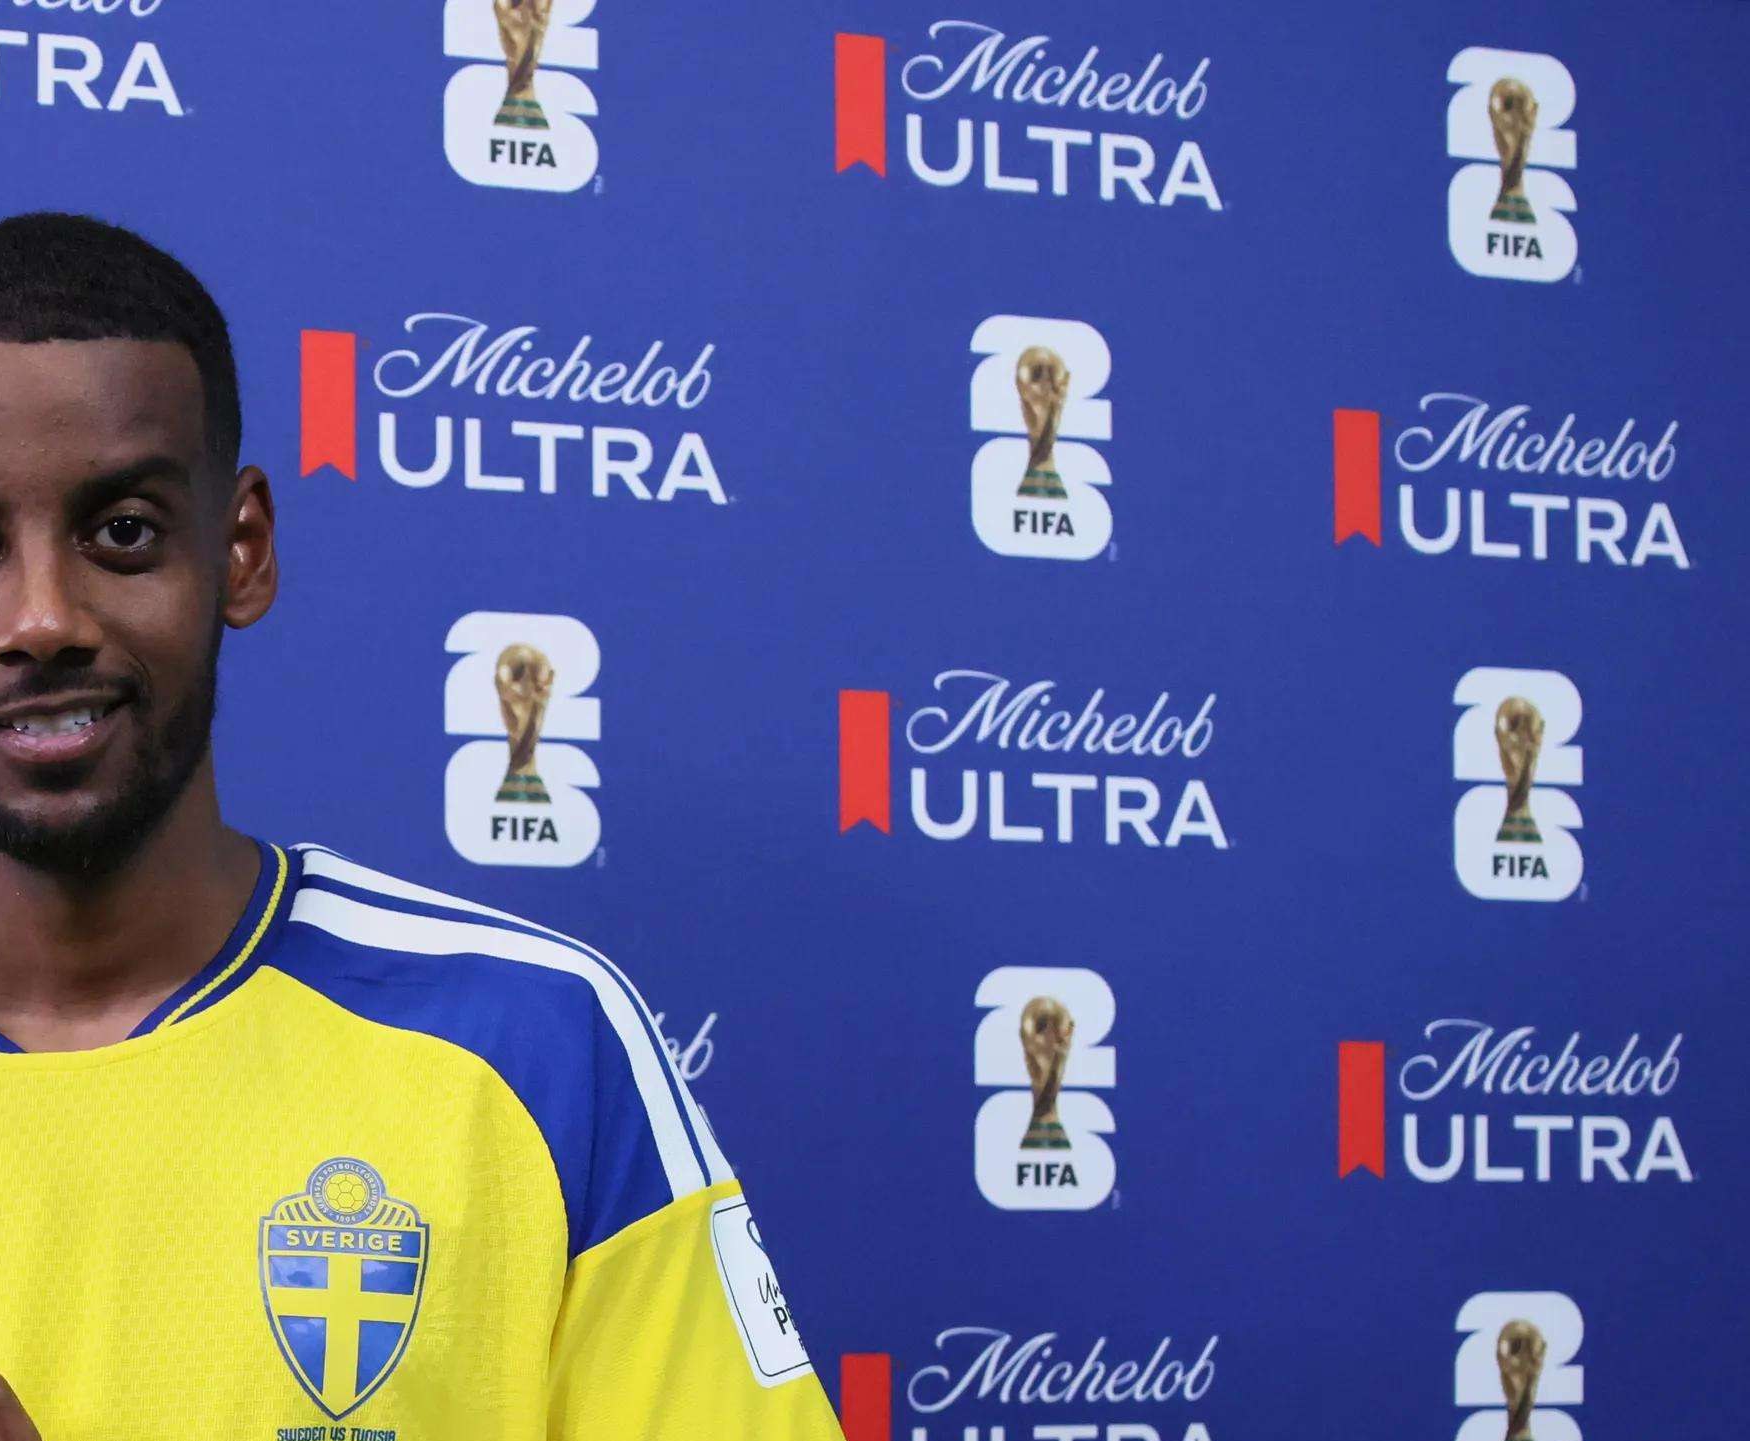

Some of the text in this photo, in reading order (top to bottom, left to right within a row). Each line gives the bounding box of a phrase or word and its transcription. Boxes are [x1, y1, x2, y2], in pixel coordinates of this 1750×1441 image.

[902, 21, 1209, 119] Michelob
[491, 139, 556, 167] FIFA
[906, 114, 1222, 210] ULTRA
[1488, 233, 1542, 258] FIFA
[374, 313, 714, 408] Michelob
[379, 412, 726, 504] ULTRA
[1395, 393, 1677, 481] Michelob
[1014, 510, 1074, 536] FIFA
[1400, 485, 1689, 569] ULTRA
[906, 670, 1215, 757] Michelob
[492, 817, 558, 842] FIFA
[911, 768, 1228, 848] ULTRA
[1493, 855, 1548, 878] FIFA
[1400, 1019, 1682, 1100] Michelob
[1017, 1164, 1077, 1186] FIFA
[1404, 1114, 1692, 1182] ULTRA
[286, 1230, 403, 1251] SVERIGE
[908, 1327, 1218, 1412] Michelob
